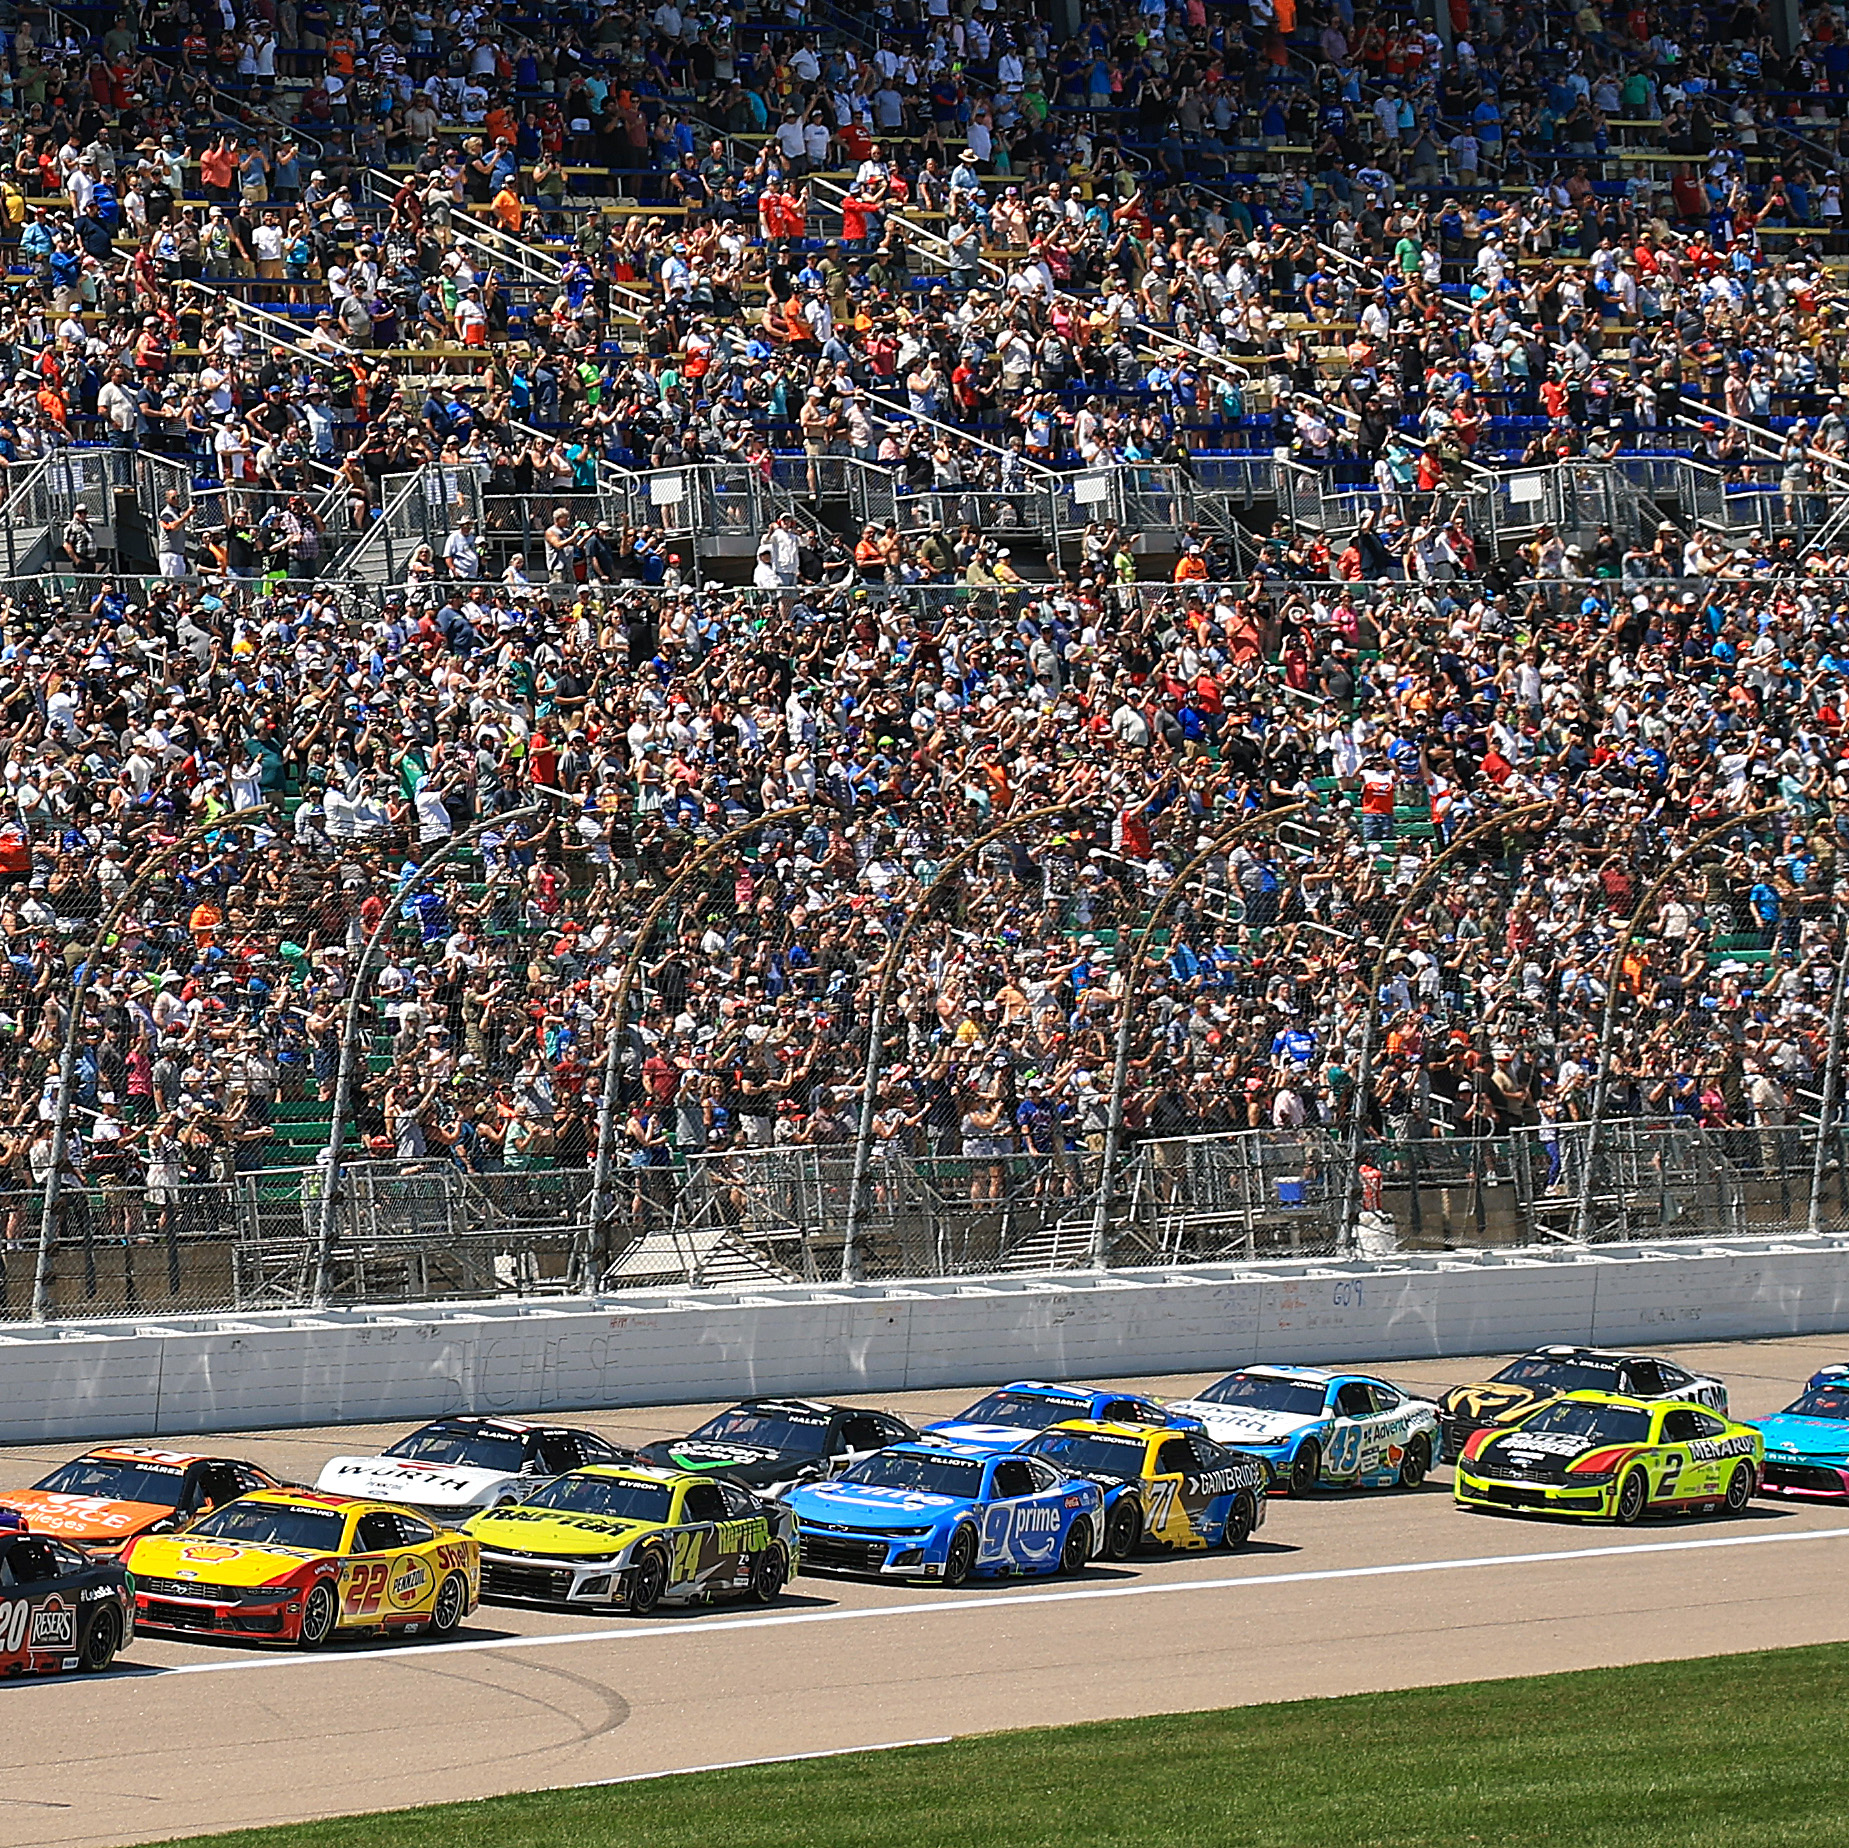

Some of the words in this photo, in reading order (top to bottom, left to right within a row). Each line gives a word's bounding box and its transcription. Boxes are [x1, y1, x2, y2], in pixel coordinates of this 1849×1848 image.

[1579, 1360, 1616, 1372] DILLON
[477, 1429, 517, 1442] BLANEY
[788, 1416, 826, 1426] HALEY
[1372, 1407, 1431, 1442] AdventHealth
[930, 1456, 975, 1468] ELLIOTT
[1325, 1425, 1362, 1474] 43
[1687, 1435, 1756, 1462] MENARDS
[135, 1462, 184, 1476] SUÁREZ
[1654, 1450, 1683, 1497] 2
[618, 1480, 658, 1491] BYRON
[800, 1483, 953, 1508] prime
[290, 1505, 335, 1519] LOGANO
[1144, 1481, 1177, 1530] 71
[482, 1508, 638, 1538] RAPTOR
[983, 1506, 1012, 1557] 9
[1015, 1502, 1061, 1539] prime
[716, 1516, 769, 1555] RAPTOR
[437, 1541, 469, 1570] Shell
[672, 1531, 704, 1583] 24
[343, 1563, 390, 1616] 22
[391, 1569, 429, 1595] PENNZOIL
[33, 1611, 71, 1641] RESER'S
